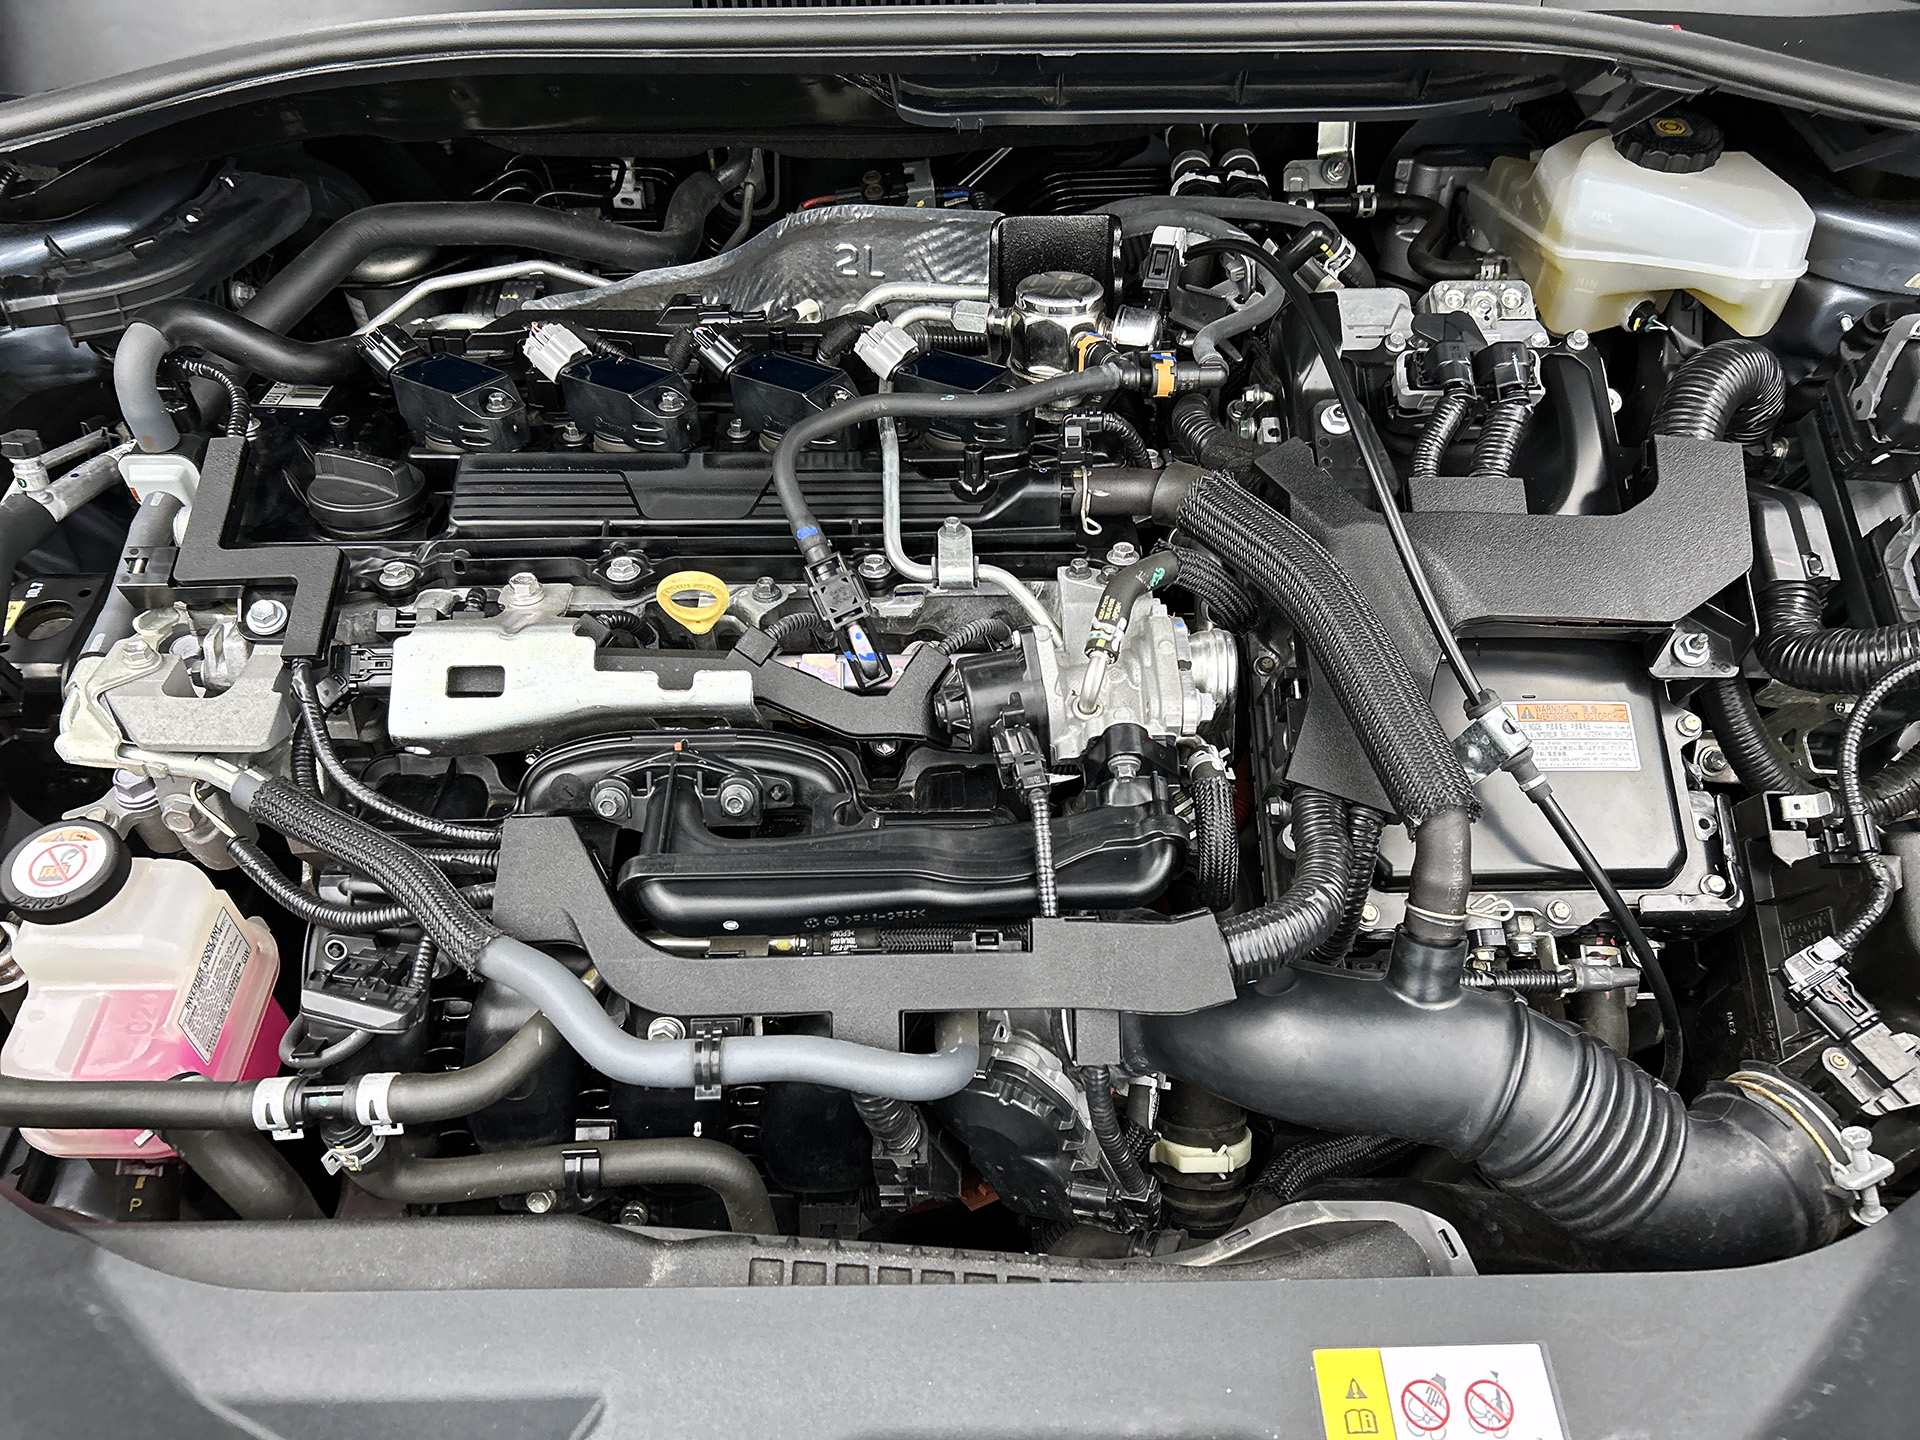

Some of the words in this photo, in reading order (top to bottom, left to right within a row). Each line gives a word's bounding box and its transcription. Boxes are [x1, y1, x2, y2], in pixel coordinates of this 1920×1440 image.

[833, 242, 886, 278] 2L
[1534, 704, 1569, 713] WARNING
[1536, 712, 1578, 721] AVERTISSEMENT
[11, 893, 68, 909] DENSO
[185, 966, 204, 1010] INVERTER
[202, 922, 221, 967] COOLANT
[129, 1197, 142, 1213] P
